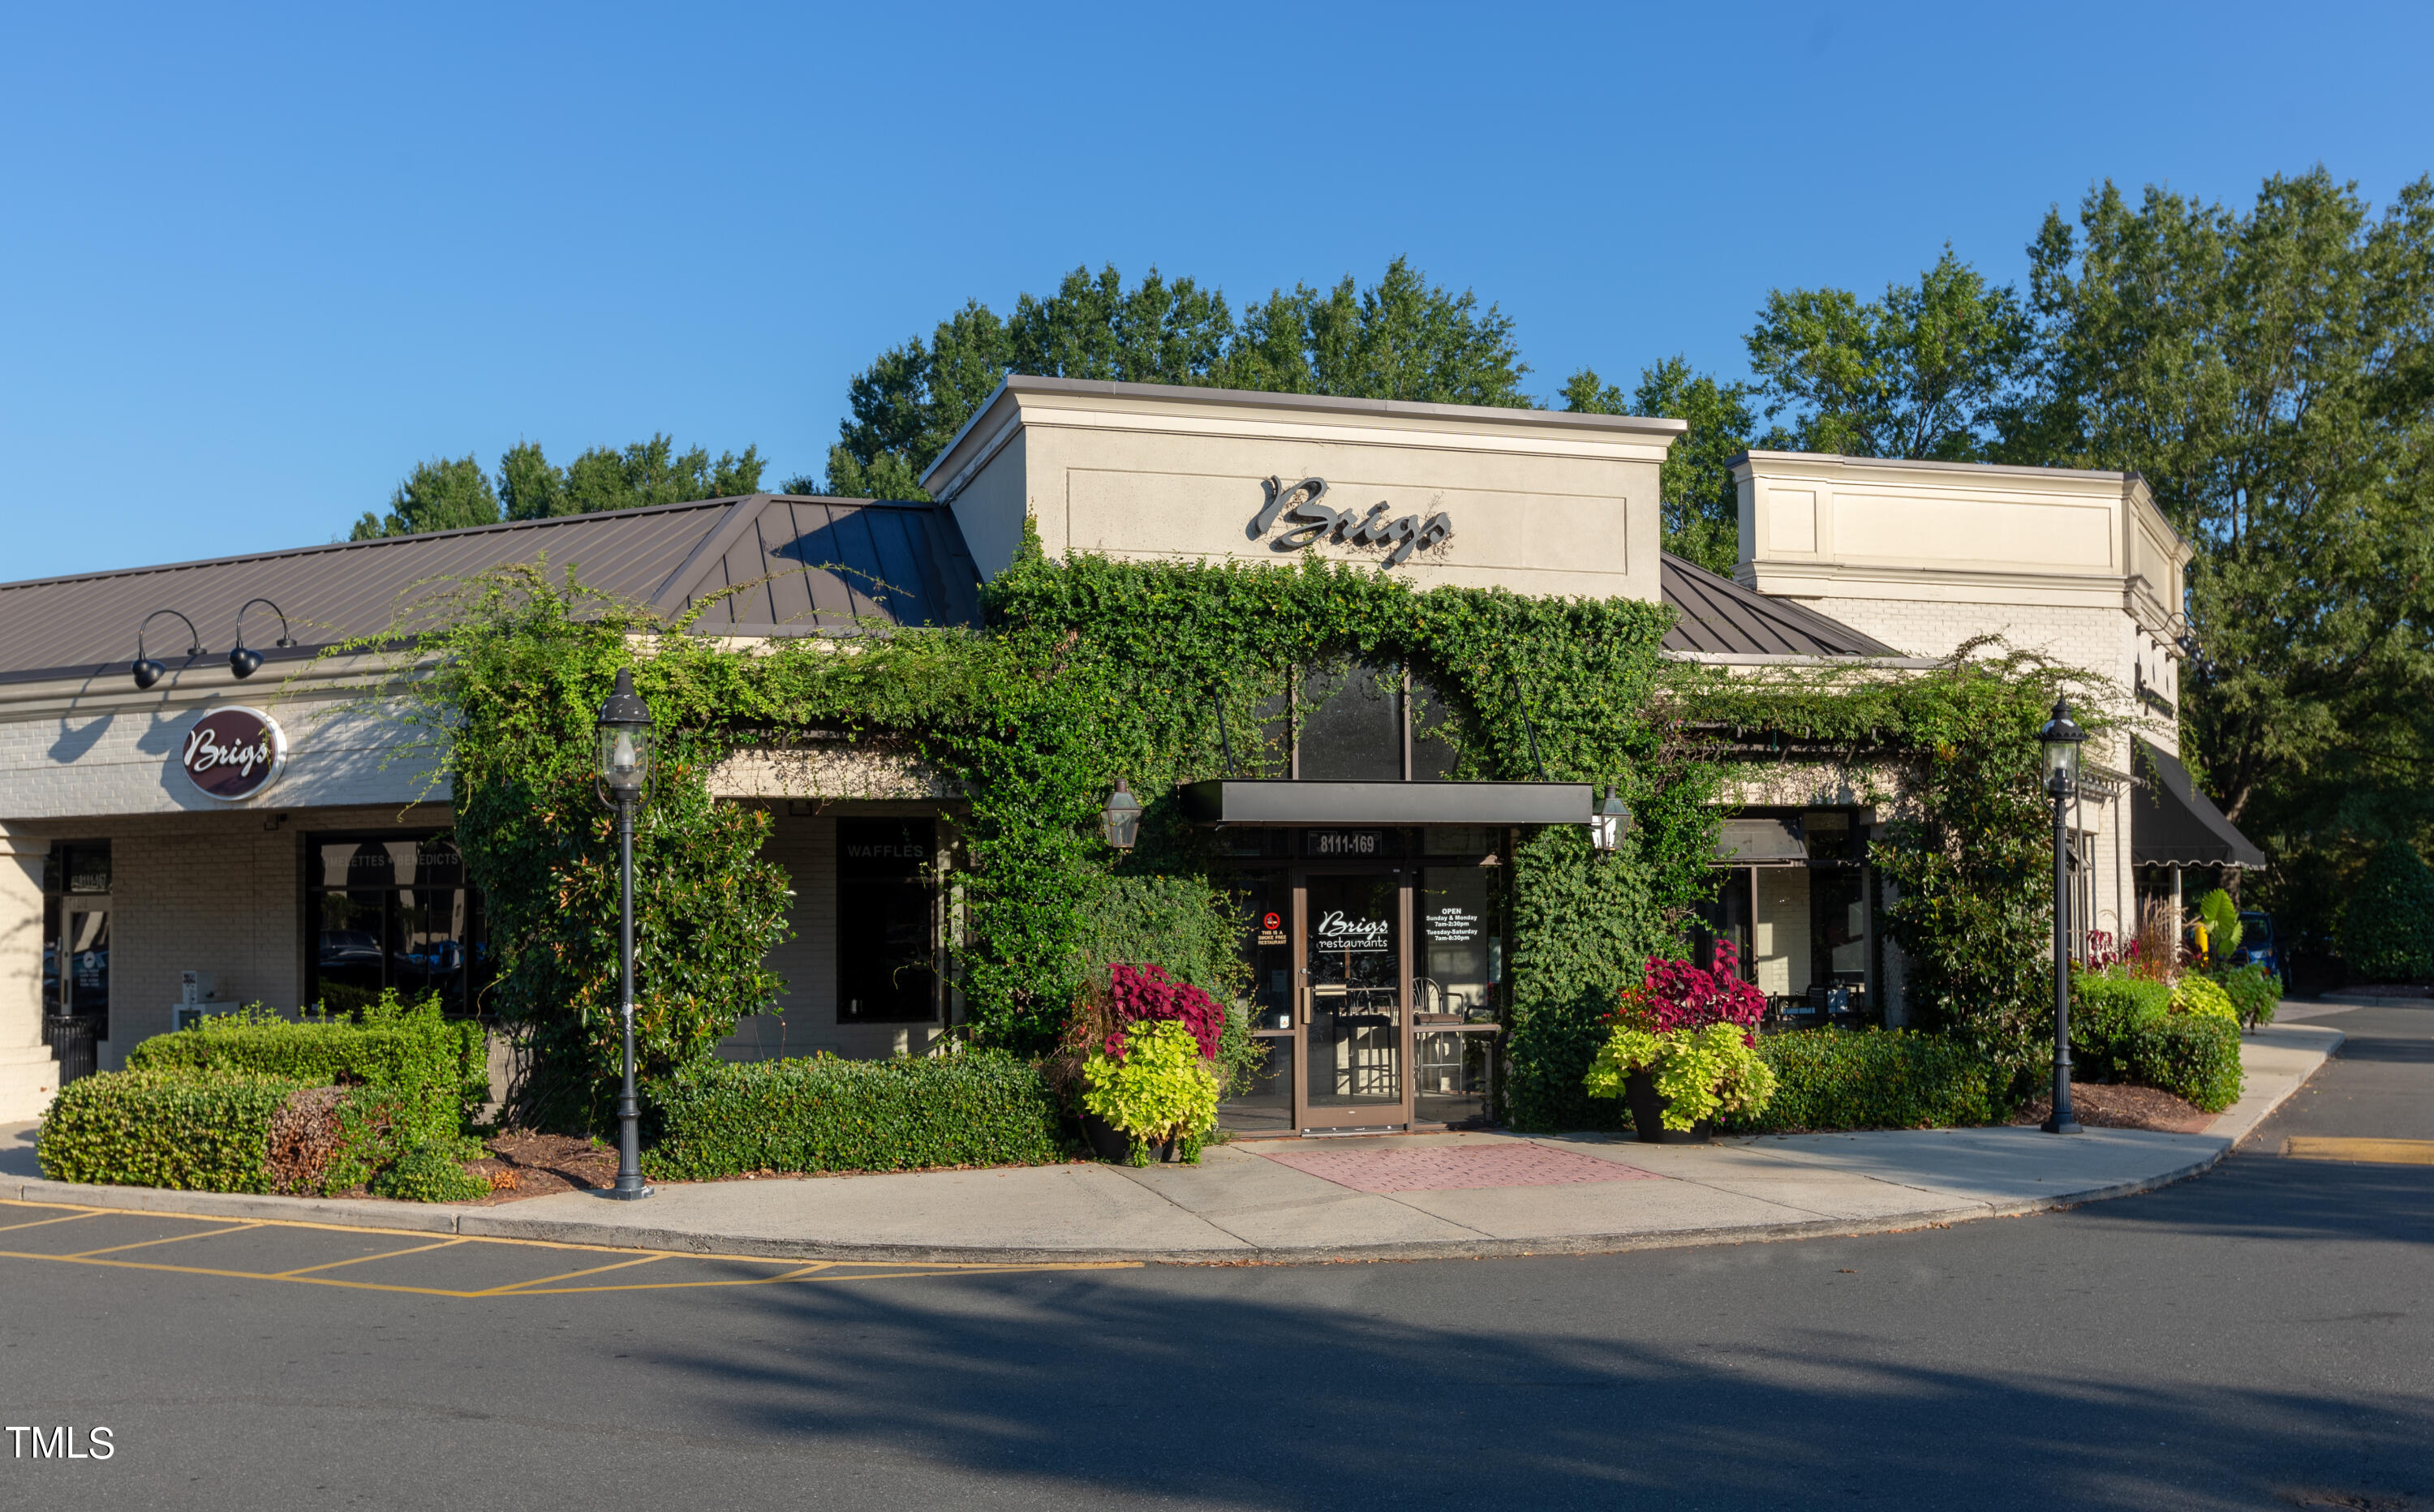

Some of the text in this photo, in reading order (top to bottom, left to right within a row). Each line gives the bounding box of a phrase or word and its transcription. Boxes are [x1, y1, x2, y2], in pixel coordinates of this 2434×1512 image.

[1257, 475, 1451, 564] Brigs
[184, 728, 267, 777] Brigs
[847, 844, 923, 857] WAFFLES
[1320, 835, 1374, 853] 8111-169
[396, 853, 458, 866] BENEDICTS
[1318, 911, 1388, 940] Brigs
[1318, 936, 1387, 948] restaurants
